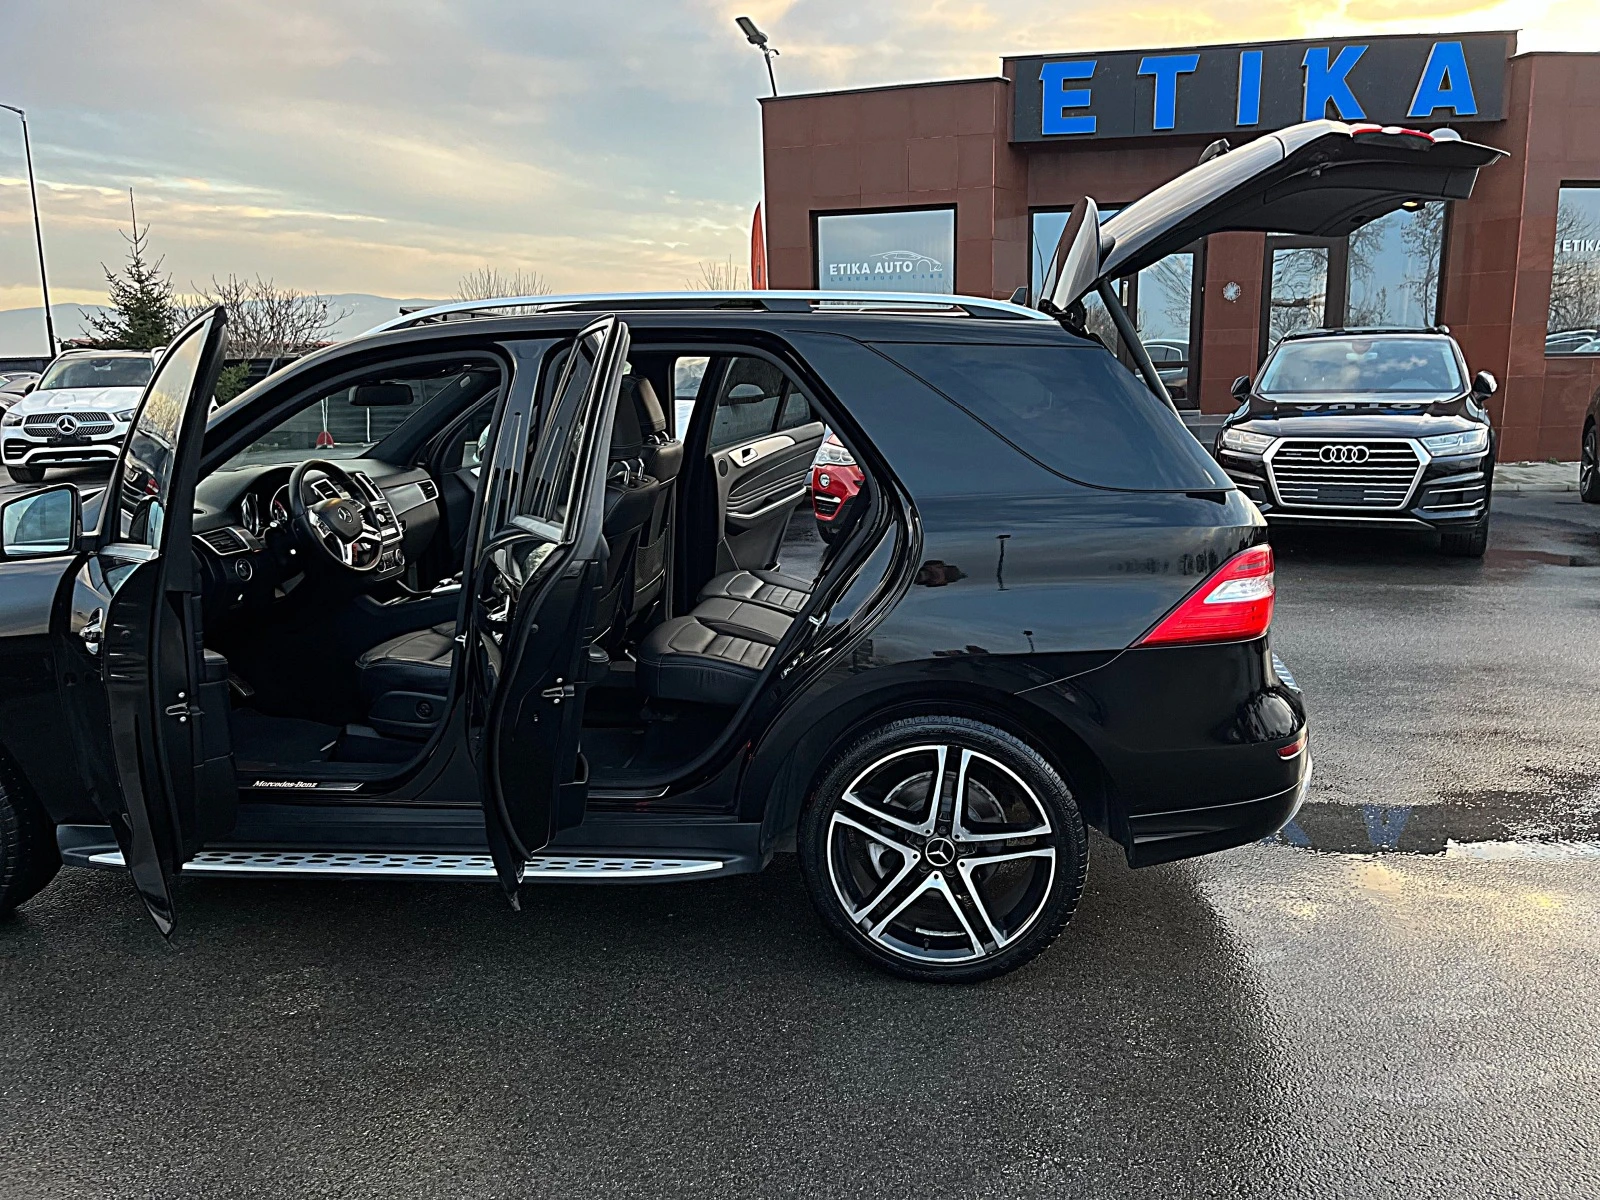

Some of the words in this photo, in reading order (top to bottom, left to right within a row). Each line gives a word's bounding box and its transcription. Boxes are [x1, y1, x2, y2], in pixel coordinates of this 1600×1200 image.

[1038, 41, 1478, 135] ETIKA
[829, 262, 871, 276] ETIKA
[874, 261, 913, 274] AUTO
[252, 780, 318, 788] Mercedes-Benz
